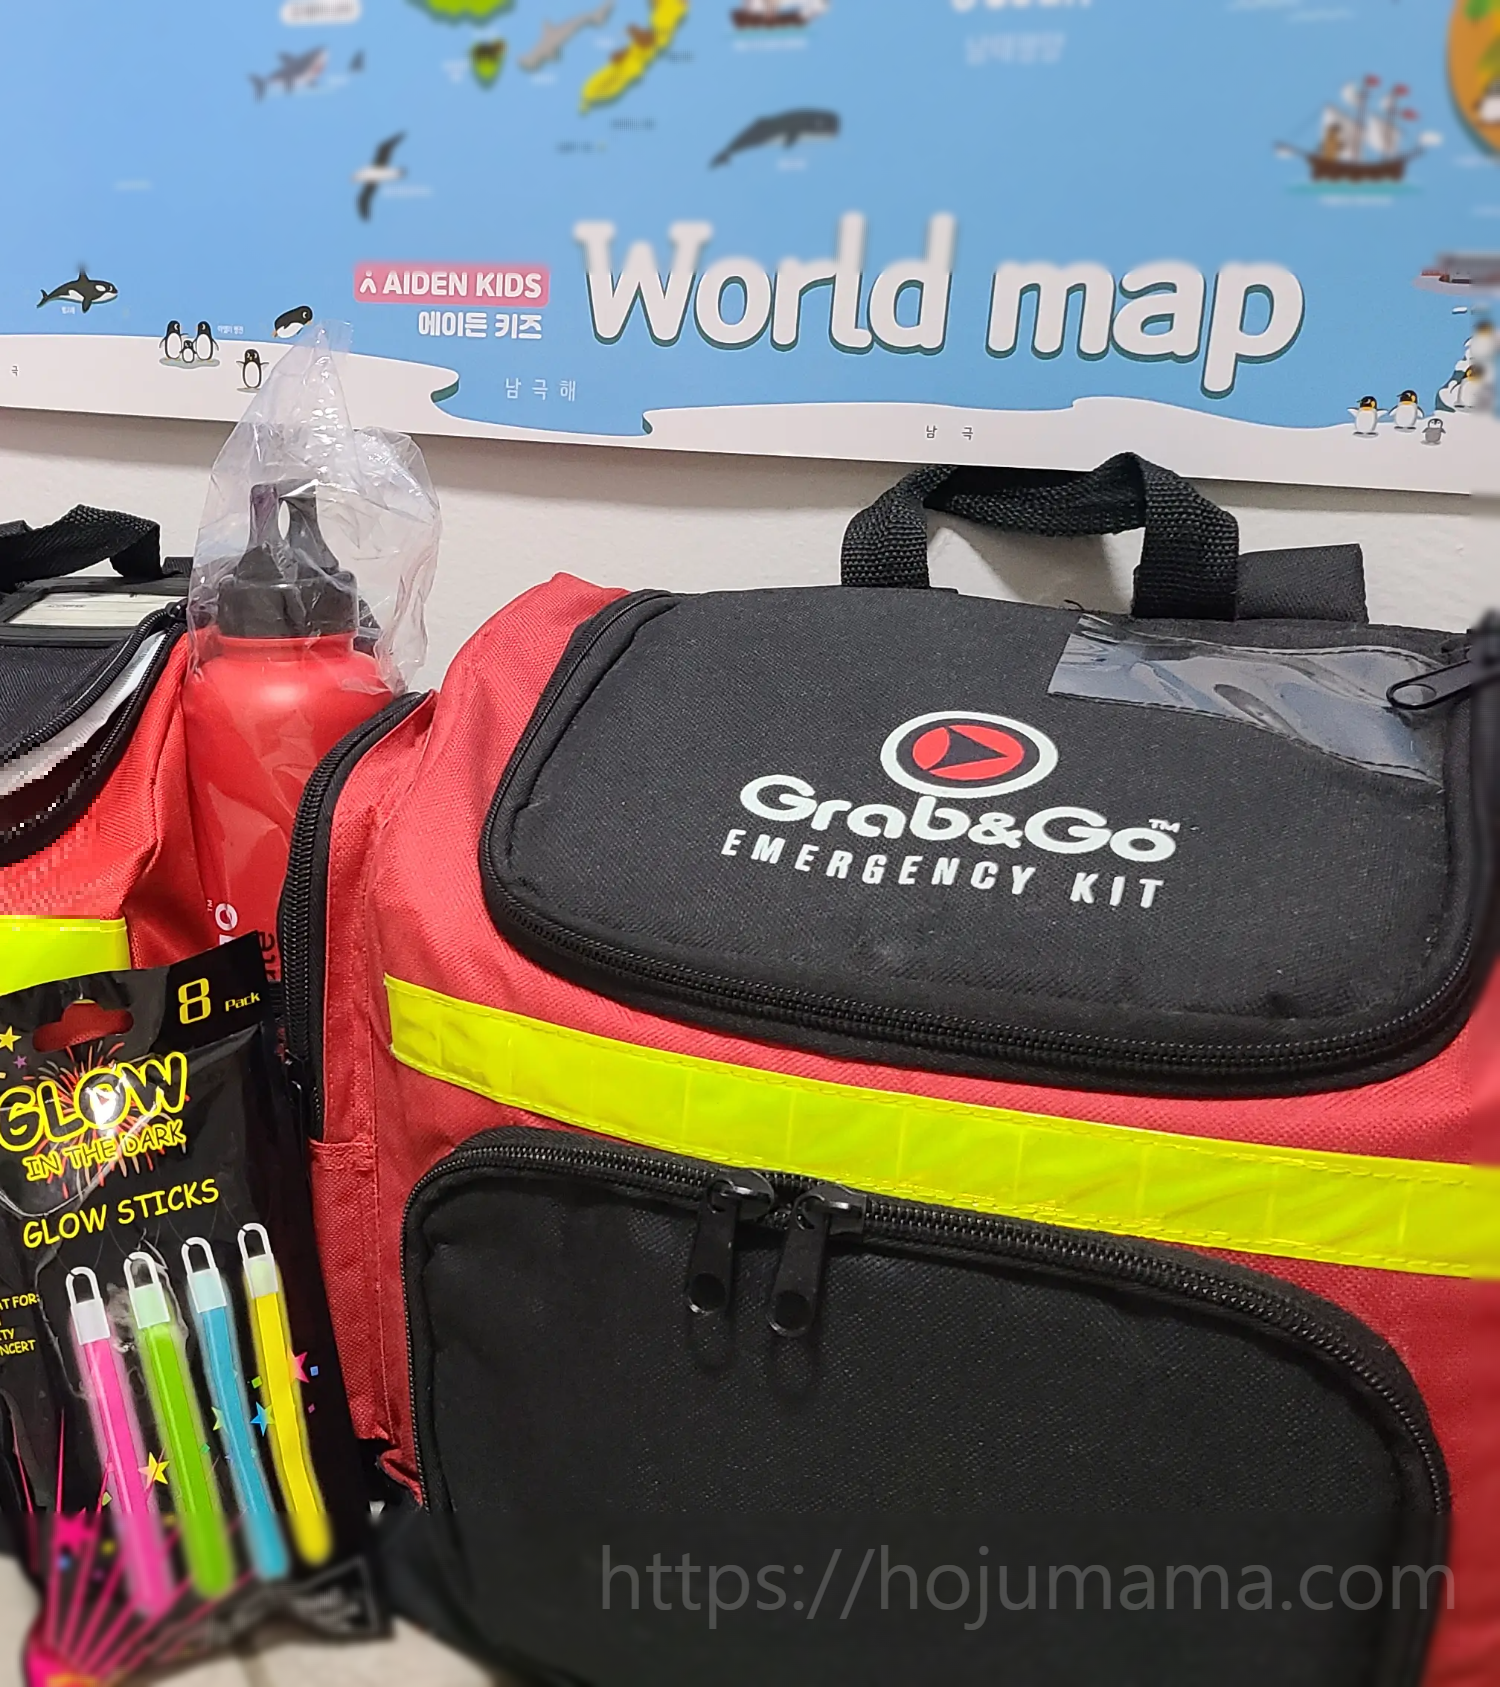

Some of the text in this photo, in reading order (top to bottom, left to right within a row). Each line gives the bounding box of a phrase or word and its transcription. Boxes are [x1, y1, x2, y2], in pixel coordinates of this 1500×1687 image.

[382, 270, 542, 299] AIDEN KIDS
[573, 210, 1305, 399] World map
[418, 310, 542, 340] 에이든 키즈
[720, 828, 1166, 909] EMERGENCY KIT
[177, 977, 261, 1025] 8 Pack
[22, 1118, 187, 1181] IN THE DARK
[23, 1178, 220, 1249] GLOW STICKS
